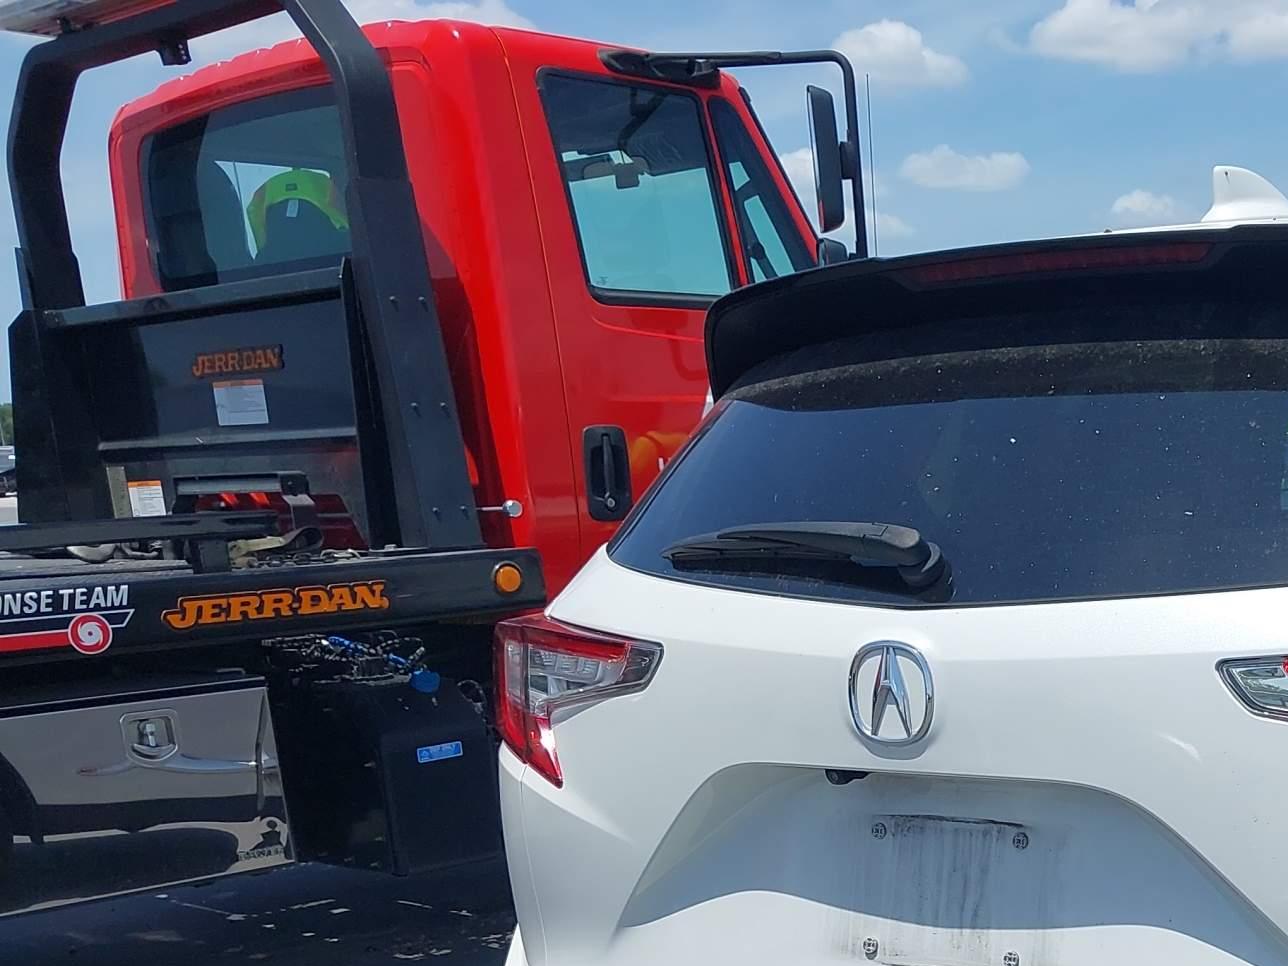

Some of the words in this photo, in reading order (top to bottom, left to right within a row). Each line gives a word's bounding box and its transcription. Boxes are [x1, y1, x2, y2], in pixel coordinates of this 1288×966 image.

[0, 590, 54, 616] NSE
[58, 584, 129, 611] TEAM
[164, 582, 386, 629] JERR-DAN
